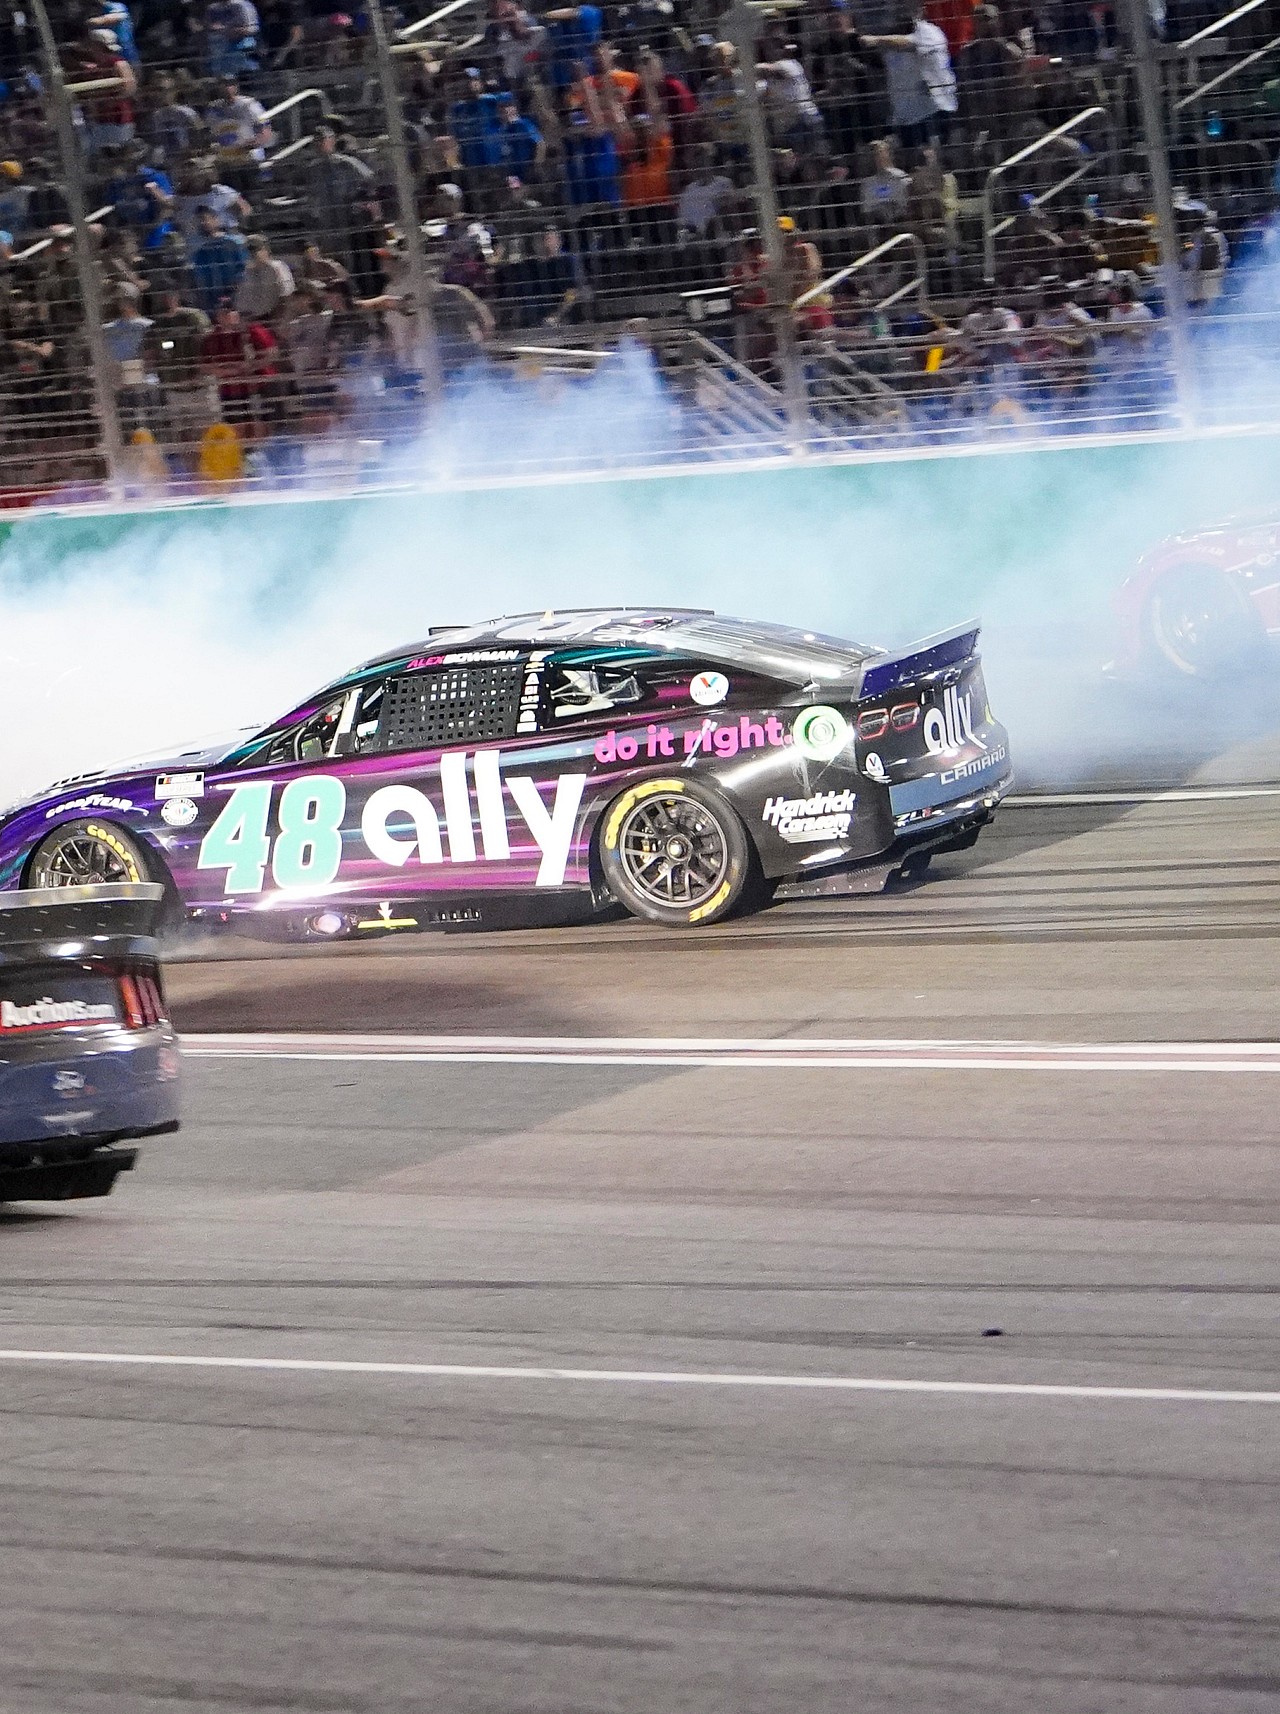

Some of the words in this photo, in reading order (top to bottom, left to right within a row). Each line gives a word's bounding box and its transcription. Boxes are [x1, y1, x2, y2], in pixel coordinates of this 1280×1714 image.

[923, 685, 988, 755] ally
[593, 731, 639, 763] do
[647, 725, 675, 758] it
[940, 747, 1007, 786] CAMARO
[45, 793, 133, 819] GOODYEAR
[362, 749, 587, 887] ally
[762, 789, 857, 827] Hendrick
[197, 774, 347, 895] 48
